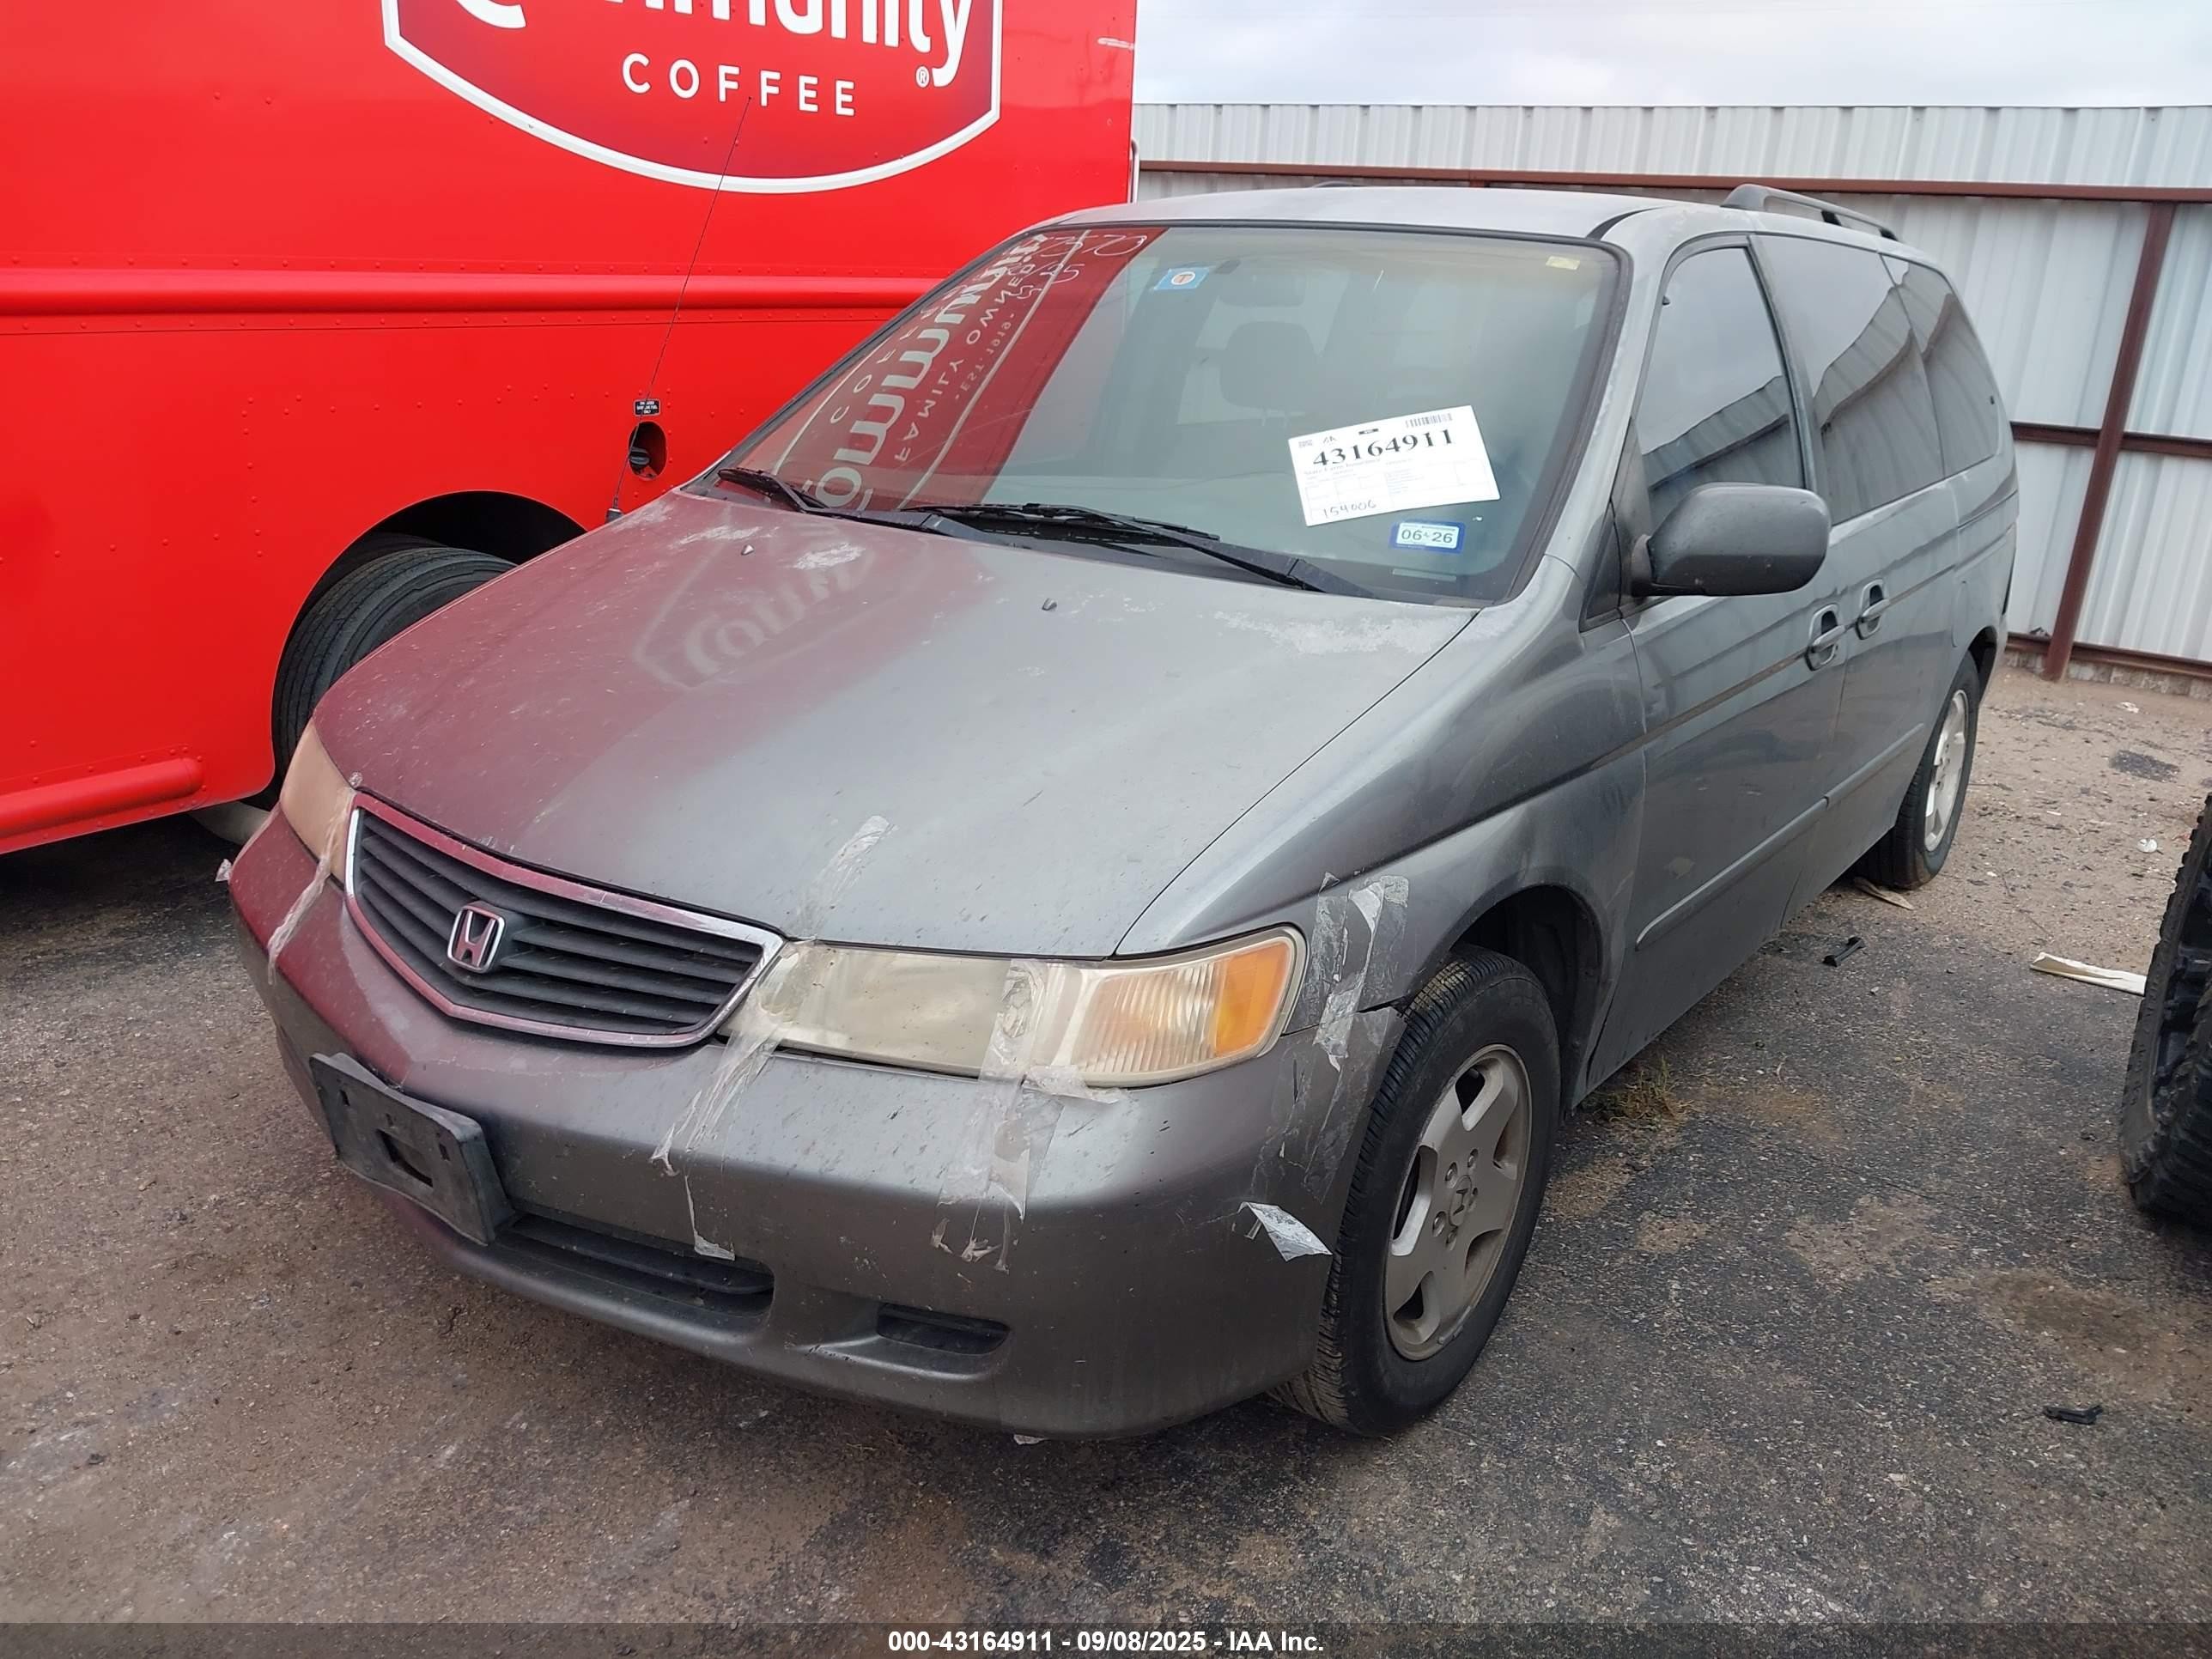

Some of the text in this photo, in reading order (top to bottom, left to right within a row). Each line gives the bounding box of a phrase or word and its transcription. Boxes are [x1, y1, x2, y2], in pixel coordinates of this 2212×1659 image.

[623, 53, 855, 117] COFFEE
[1313, 428, 1455, 466] 43164911
[1401, 529, 1453, 544] 06 26
